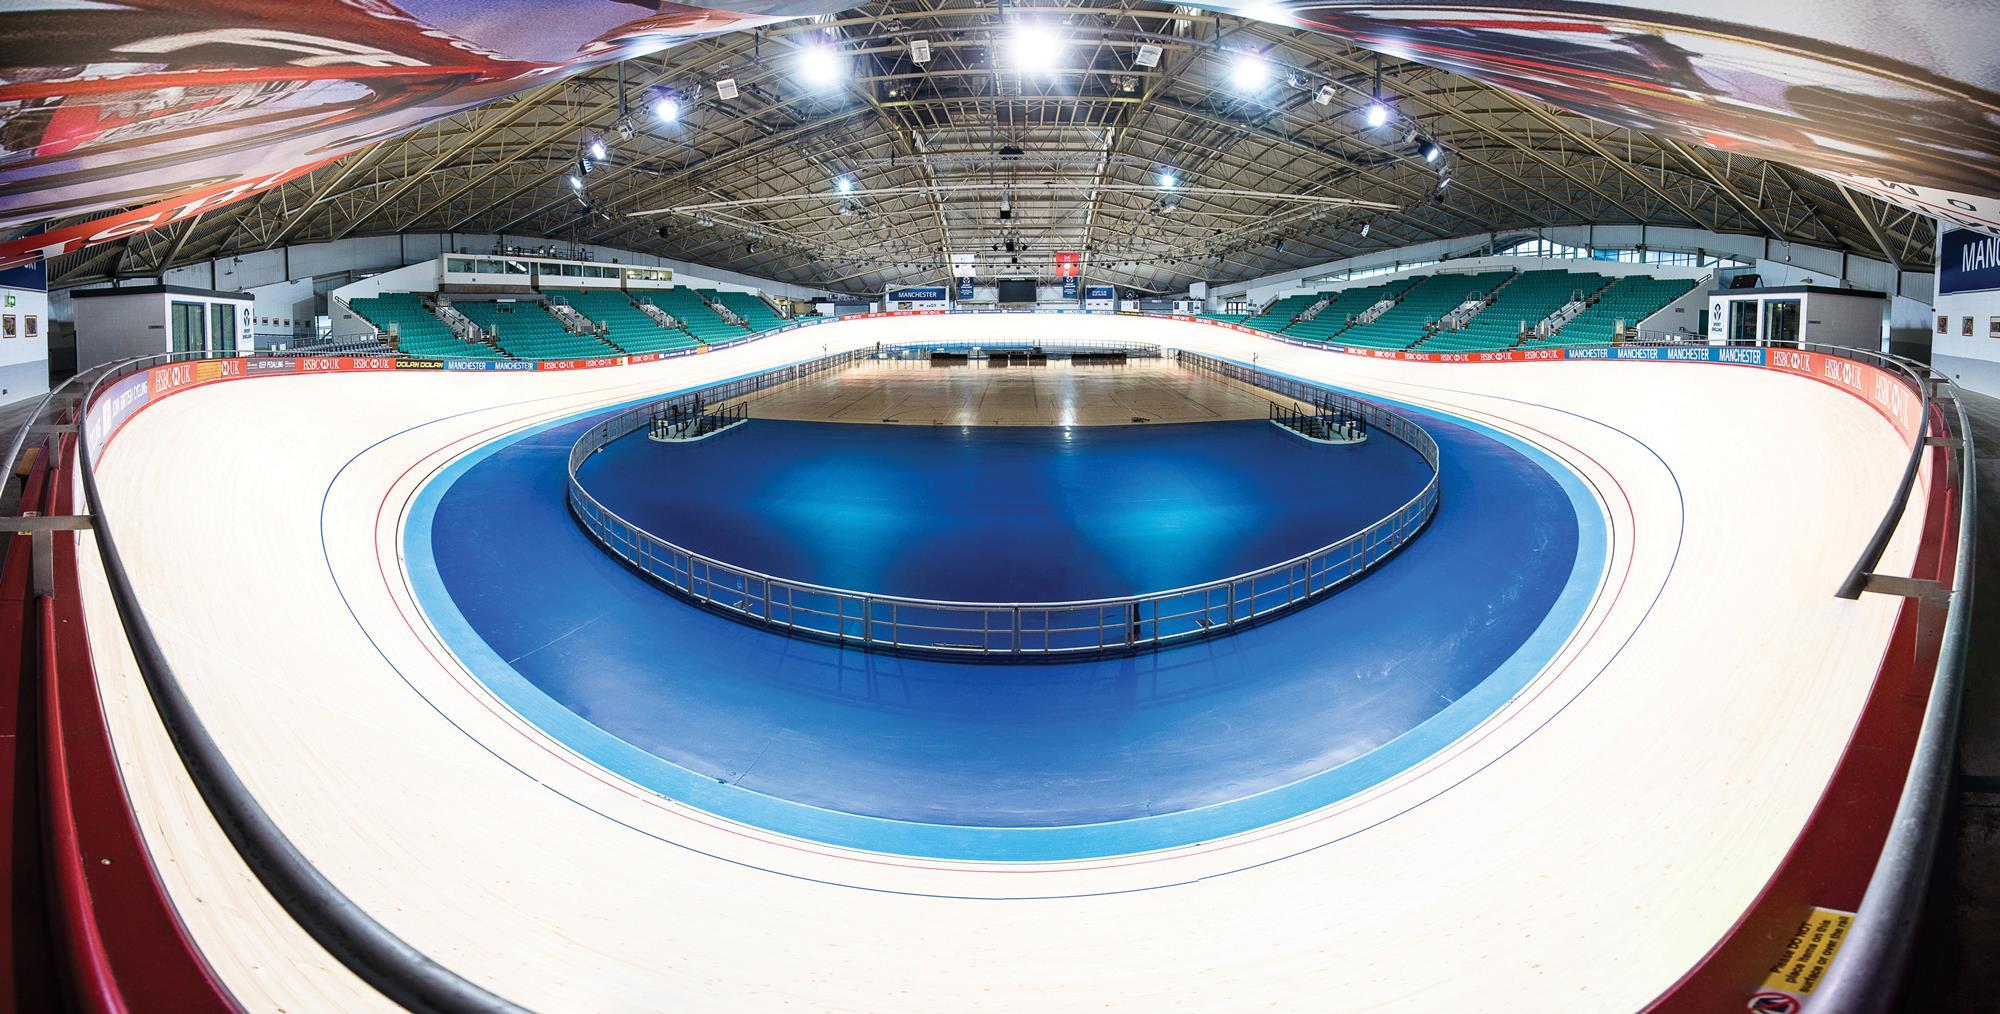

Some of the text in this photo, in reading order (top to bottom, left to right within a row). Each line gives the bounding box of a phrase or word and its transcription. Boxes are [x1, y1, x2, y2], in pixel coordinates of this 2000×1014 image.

[1503, 352, 1512, 360] UK
[1524, 351, 1558, 359] HSBC UK
[1569, 348, 1608, 359] MANCHESTER
[1617, 348, 1658, 359] MANCHESTER
[1667, 348, 1709, 361] MANCHESTER
[1719, 348, 1761, 364] MANCHESTER
[230, 360, 240, 375] UK
[303, 359, 340, 370] HSBC UK
[353, 359, 389, 369] HSBC UK
[448, 361, 486, 370] MANCHESTER
[495, 361, 533, 370] MANCHESTER
[544, 362, 559, 370] HSBC
[1773, 351, 1811, 372] HSBC UK
[155, 365, 191, 393] HSBC UK
[1824, 358, 1862, 390] HSBC UK
[1875, 374, 1909, 431] HSBC UK
[1787, 937, 1802, 950] DO
[1795, 921, 1813, 937] NOT
[1785, 920, 1831, 984] place items on this
[1798, 916, 1850, 993] surface or over the rail
